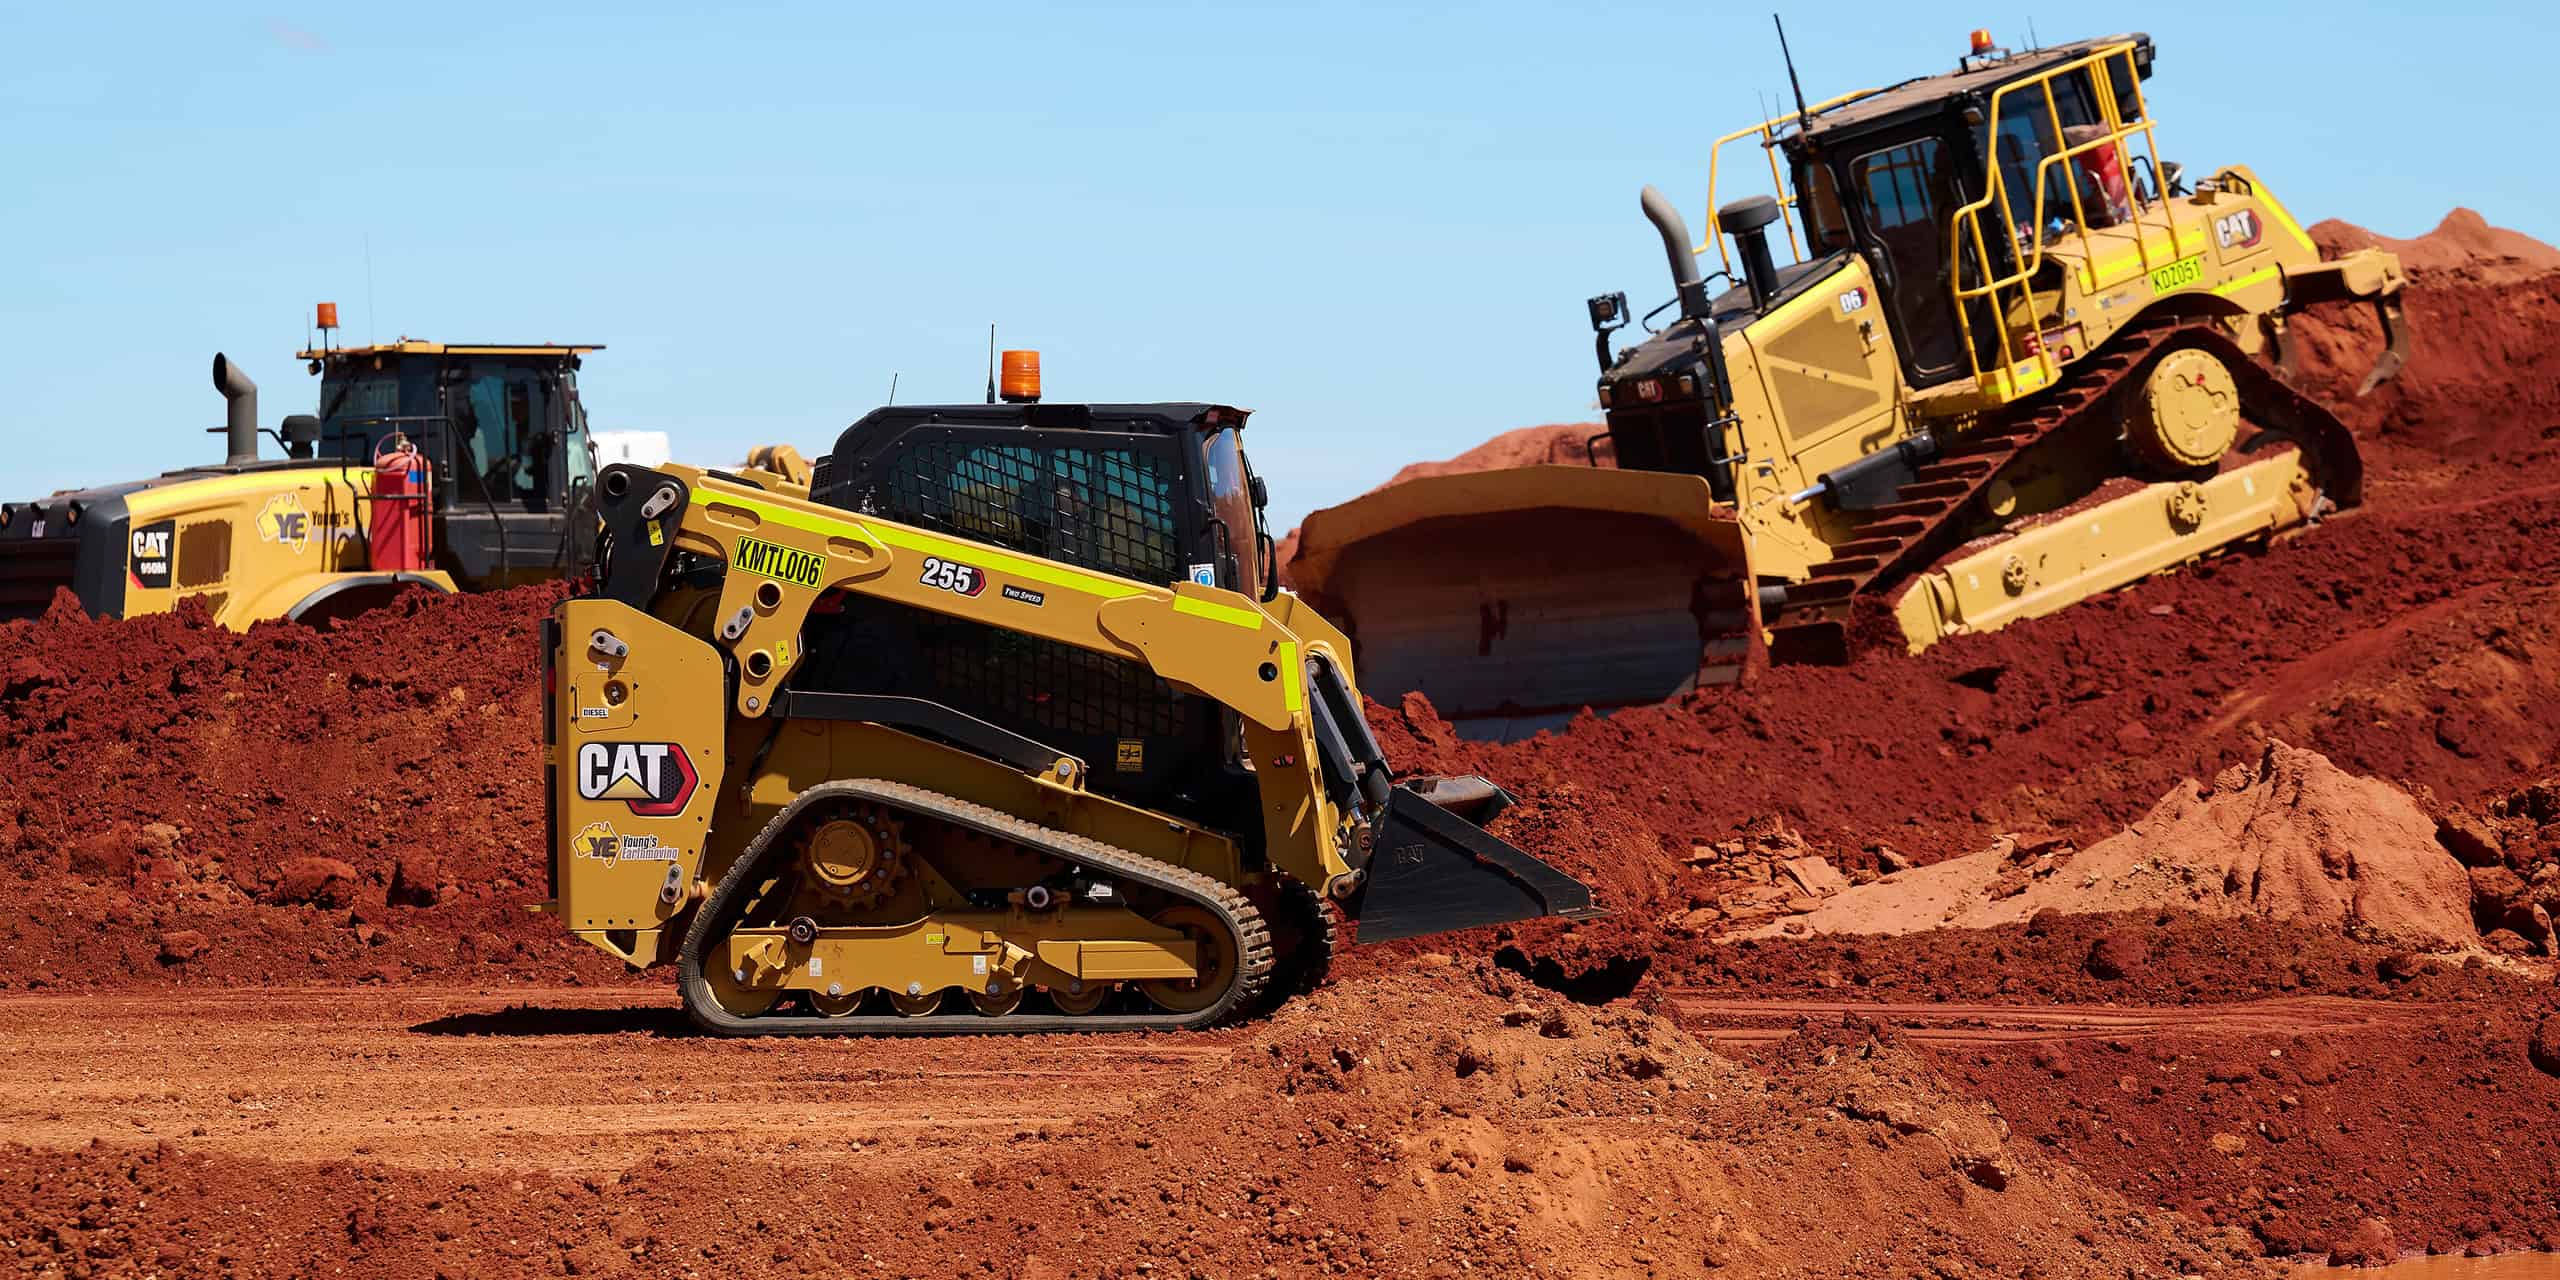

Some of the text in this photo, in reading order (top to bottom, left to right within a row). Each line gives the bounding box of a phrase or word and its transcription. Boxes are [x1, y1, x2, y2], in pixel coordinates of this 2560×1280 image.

[2215, 209, 2252, 248] CAT
[2152, 260, 2201, 292] KDZ051
[1840, 289, 1861, 312] D6
[1637, 380, 1656, 398] CAT
[31, 520, 46, 538] CAT
[274, 513, 307, 539] YE
[132, 530, 169, 558] CAT
[736, 539, 821, 586] KMTL006
[921, 557, 973, 593] 255
[583, 708, 608, 717] DIESEL
[580, 743, 668, 799] CAT
[588, 837, 618, 857] YE
[623, 835, 658, 849] Young's
